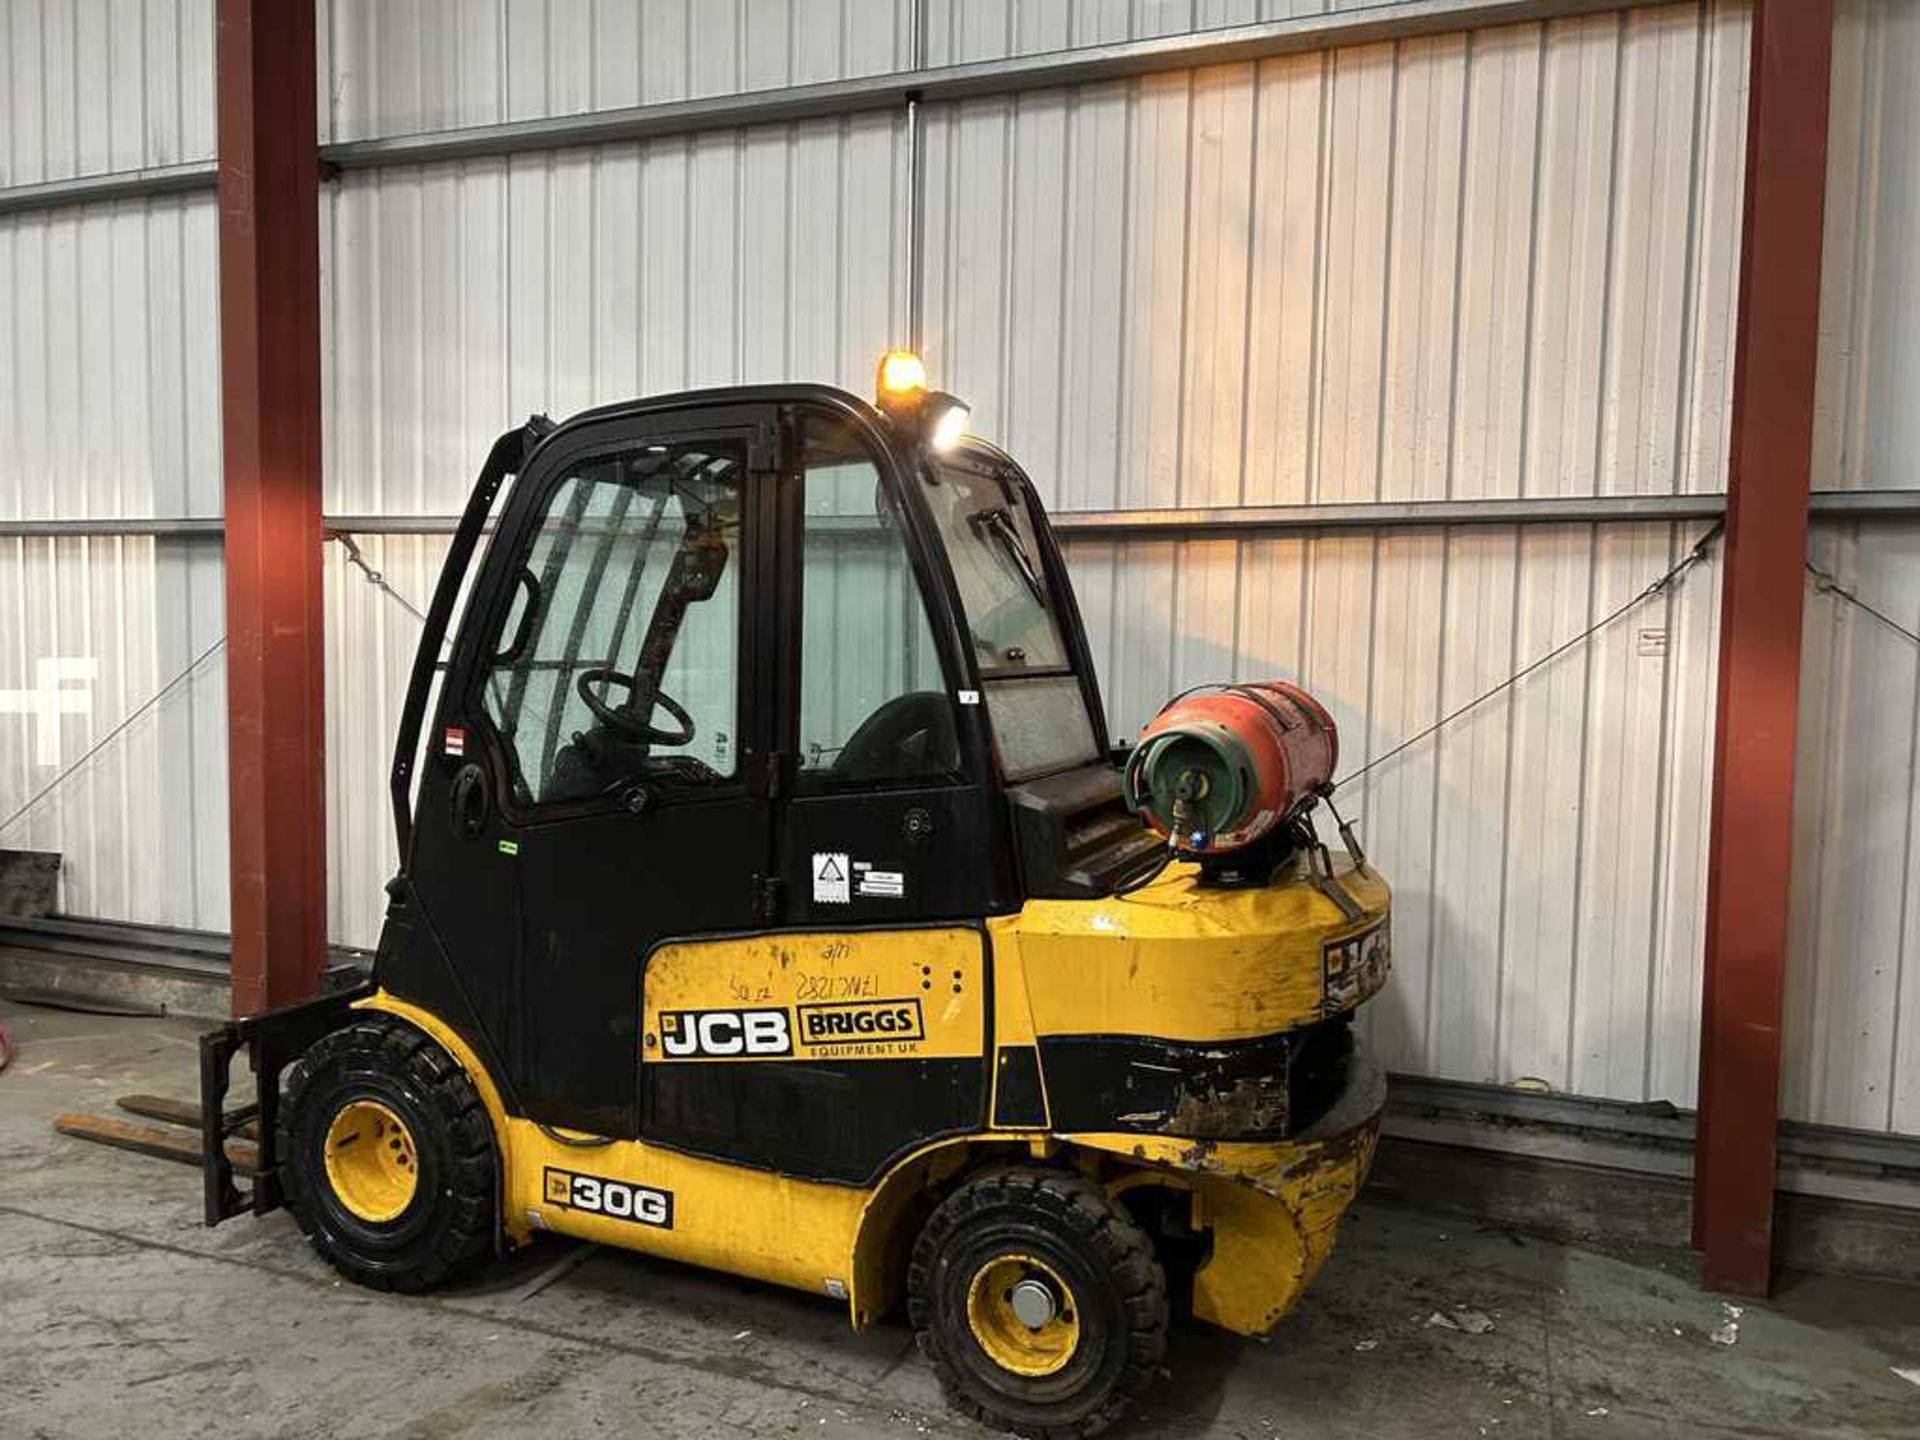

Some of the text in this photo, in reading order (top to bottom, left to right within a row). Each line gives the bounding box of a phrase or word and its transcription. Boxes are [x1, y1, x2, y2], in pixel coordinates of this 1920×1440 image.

[664, 1011, 790, 1055] JCB
[807, 1009, 913, 1035] BRIGGS
[810, 1042, 918, 1056] EQUIPMENT UK
[573, 1177, 666, 1223] 30G
